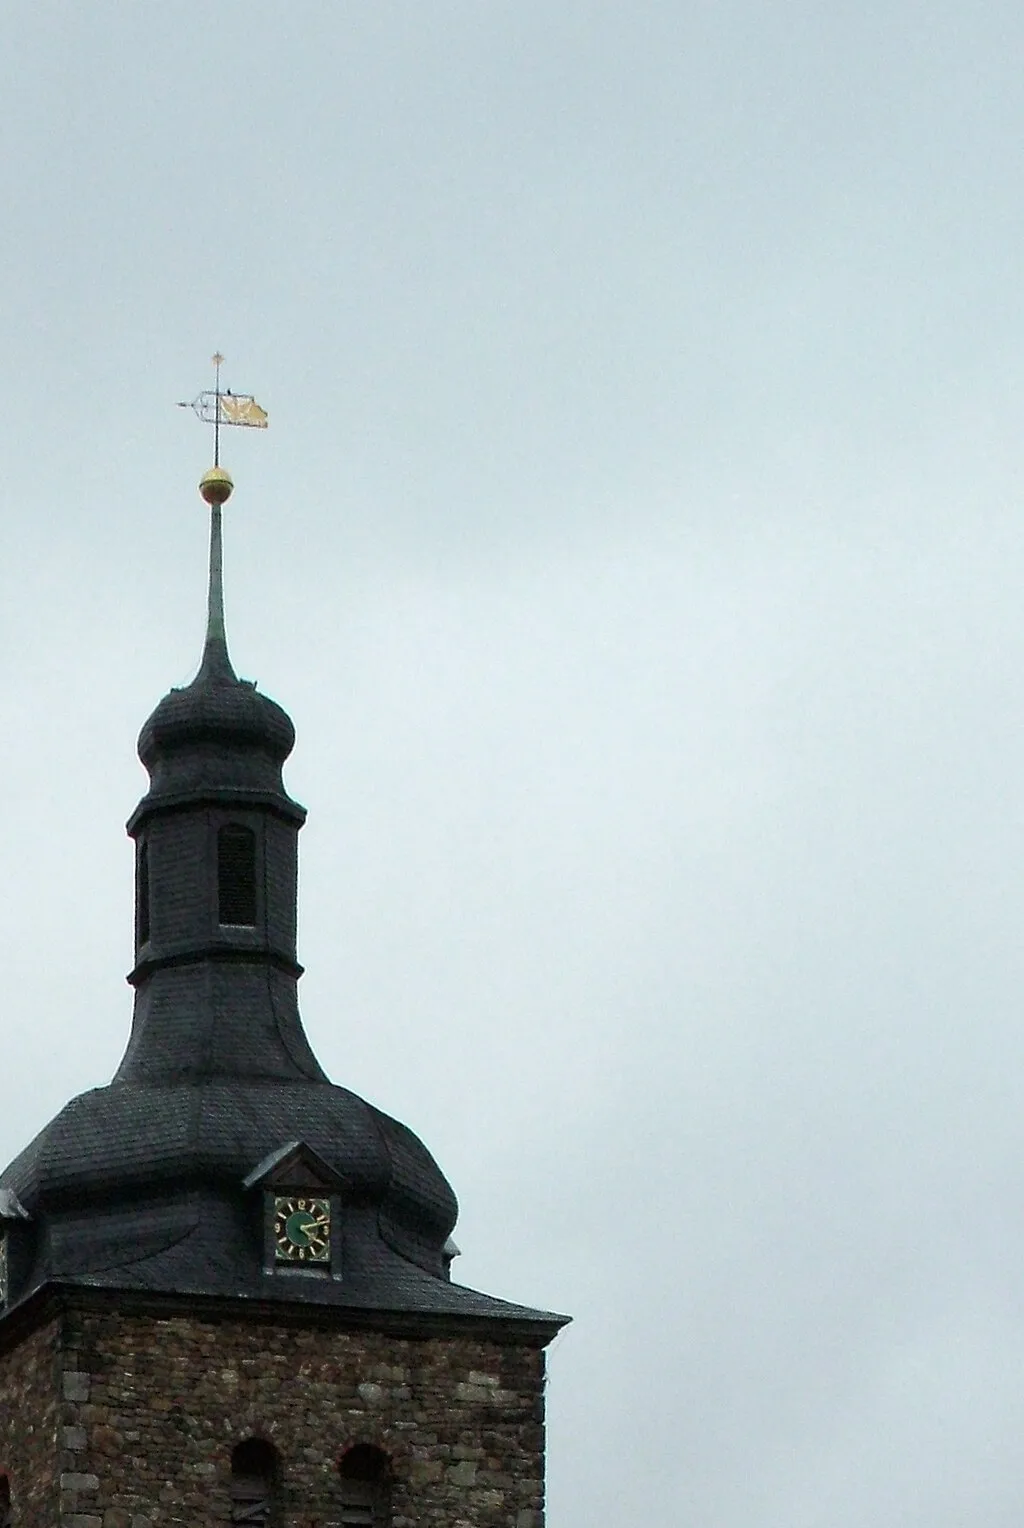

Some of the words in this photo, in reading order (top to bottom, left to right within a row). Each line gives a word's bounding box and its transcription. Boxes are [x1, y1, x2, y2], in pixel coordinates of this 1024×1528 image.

[298, 1199, 306, 1210] 12
[274, 1223, 281, 1233] 9
[299, 1248, 305, 1259] 6
